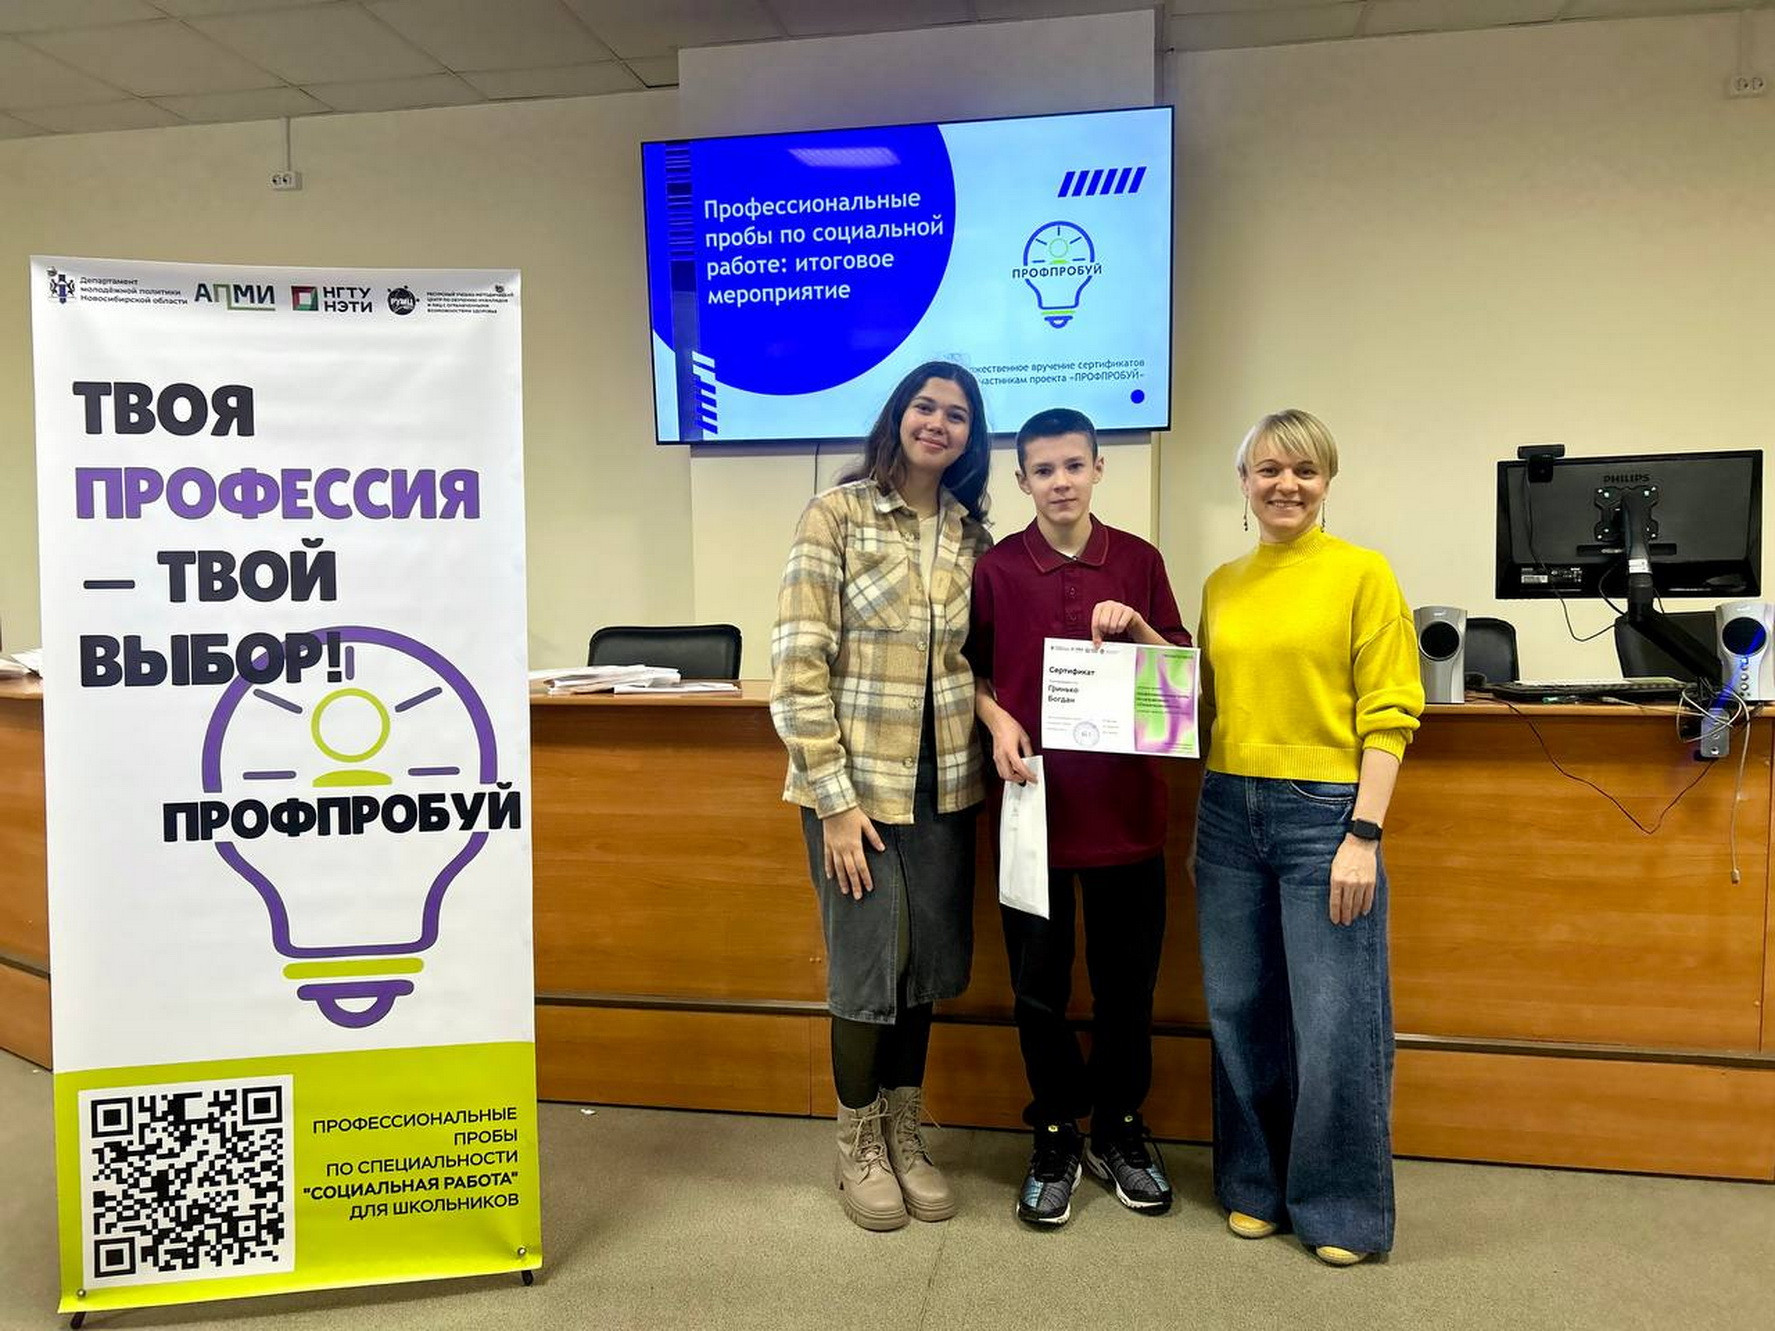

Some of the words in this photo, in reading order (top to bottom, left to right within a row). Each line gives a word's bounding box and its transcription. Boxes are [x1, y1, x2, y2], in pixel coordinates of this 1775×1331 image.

[704, 192, 921, 223] Профессиональные
[705, 226, 773, 251] пробы
[780, 227, 806, 244] по
[812, 213, 944, 244] социальной
[707, 256, 787, 281] работе:
[795, 252, 895, 272] итоговое
[1012, 263, 1102, 279] ПРОФПРОБУЙ
[80, 276, 138, 286] Департамент
[139, 288, 181, 296] политики
[323, 286, 371, 299] НГТУ
[80, 294, 151, 304] Новосибирской
[152, 296, 188, 305] области
[194, 283, 276, 311] АПМИ
[325, 301, 373, 313] НЭТИ
[708, 283, 851, 308] мероприятие
[1031, 362, 1076, 374] вручение
[1078, 358, 1145, 371] сертификатов
[1030, 374, 1067, 385] проекта
[72, 381, 256, 437] ТВОЯ
[1603, 473, 1650, 482] PHILIPS
[75, 466, 481, 520] ПРОФЕССИЯ
[157, 537, 337, 602] ТВОЙ
[80, 632, 342, 687] ВЫБОР!
[1048, 666, 1095, 676] Сертификат
[1048, 695, 1075, 703] Богдан
[163, 782, 521, 842] ПРОФПРОБУЙ
[313, 1107, 517, 1134] ПРОФЕССИОНАЛЬНЫЕ
[454, 1129, 518, 1146] ПРОБЫ
[326, 1162, 353, 1177] ПО
[358, 1150, 518, 1174] СПЕЦИАЛЬНОСТИ
[303, 1177, 439, 1200] "СОЦИАЛЬНАЯ
[443, 1171, 519, 1190] РАБОТА"
[349, 1202, 388, 1220] ДЛЯ
[393, 1193, 519, 1216] ШКОЛЬНИКОВ
